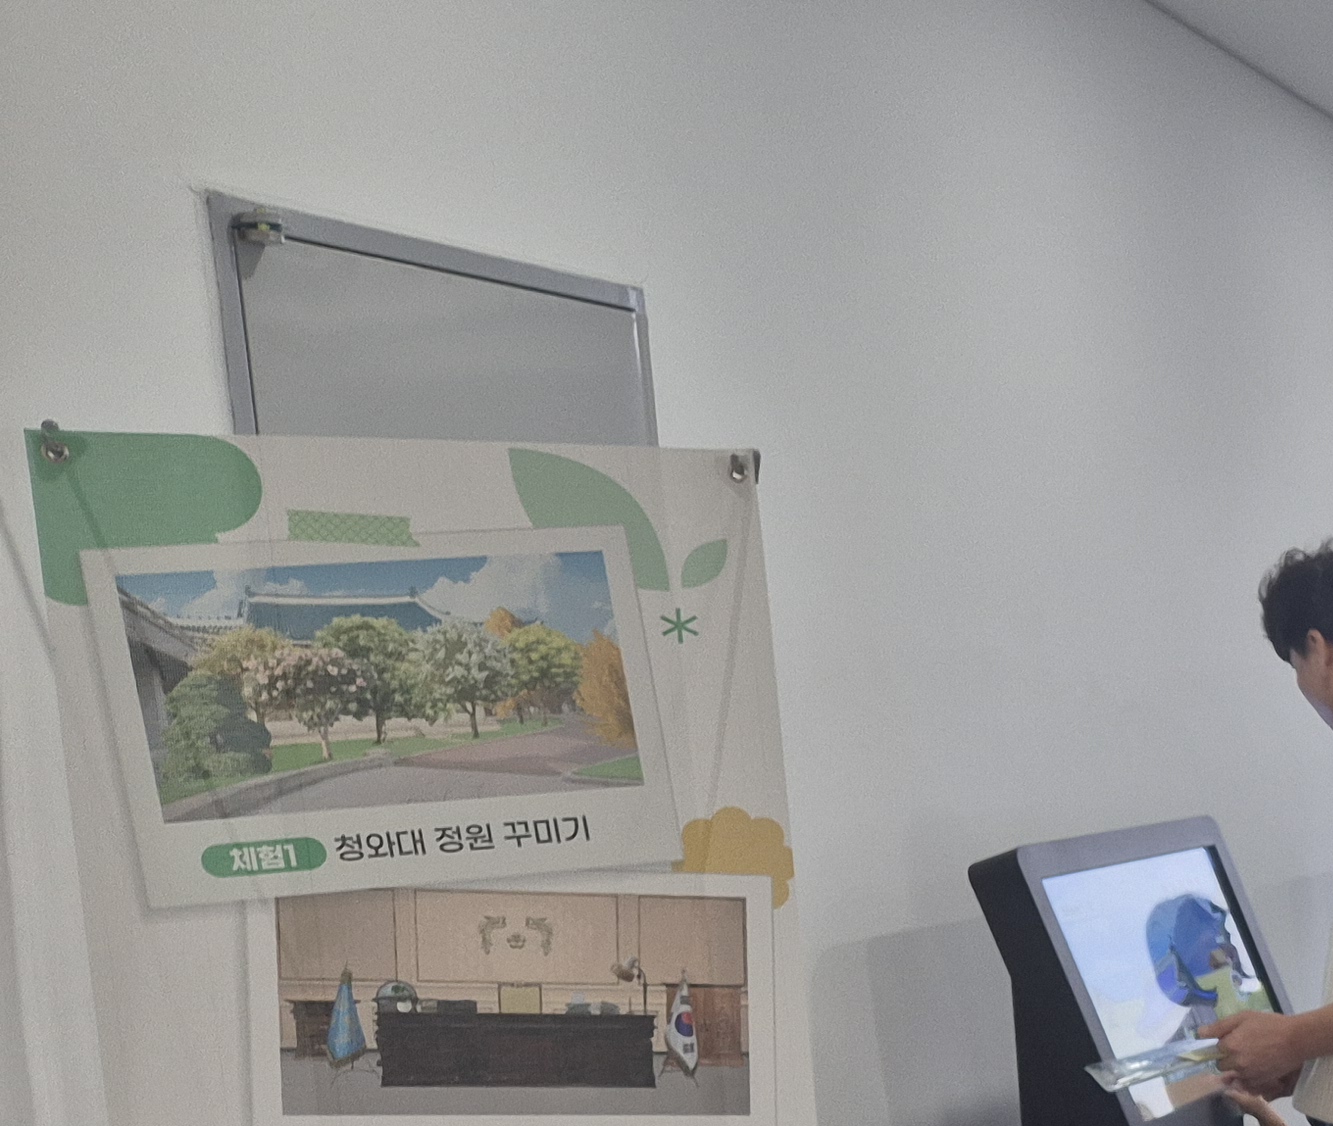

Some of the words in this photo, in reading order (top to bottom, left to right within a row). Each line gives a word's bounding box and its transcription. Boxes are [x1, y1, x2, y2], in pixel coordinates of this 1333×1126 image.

[229, 844, 299, 873] 체험1
[334, 828, 427, 863] 청와대
[434, 823, 496, 853] 정원
[503, 815, 591, 848] 꾸미기
